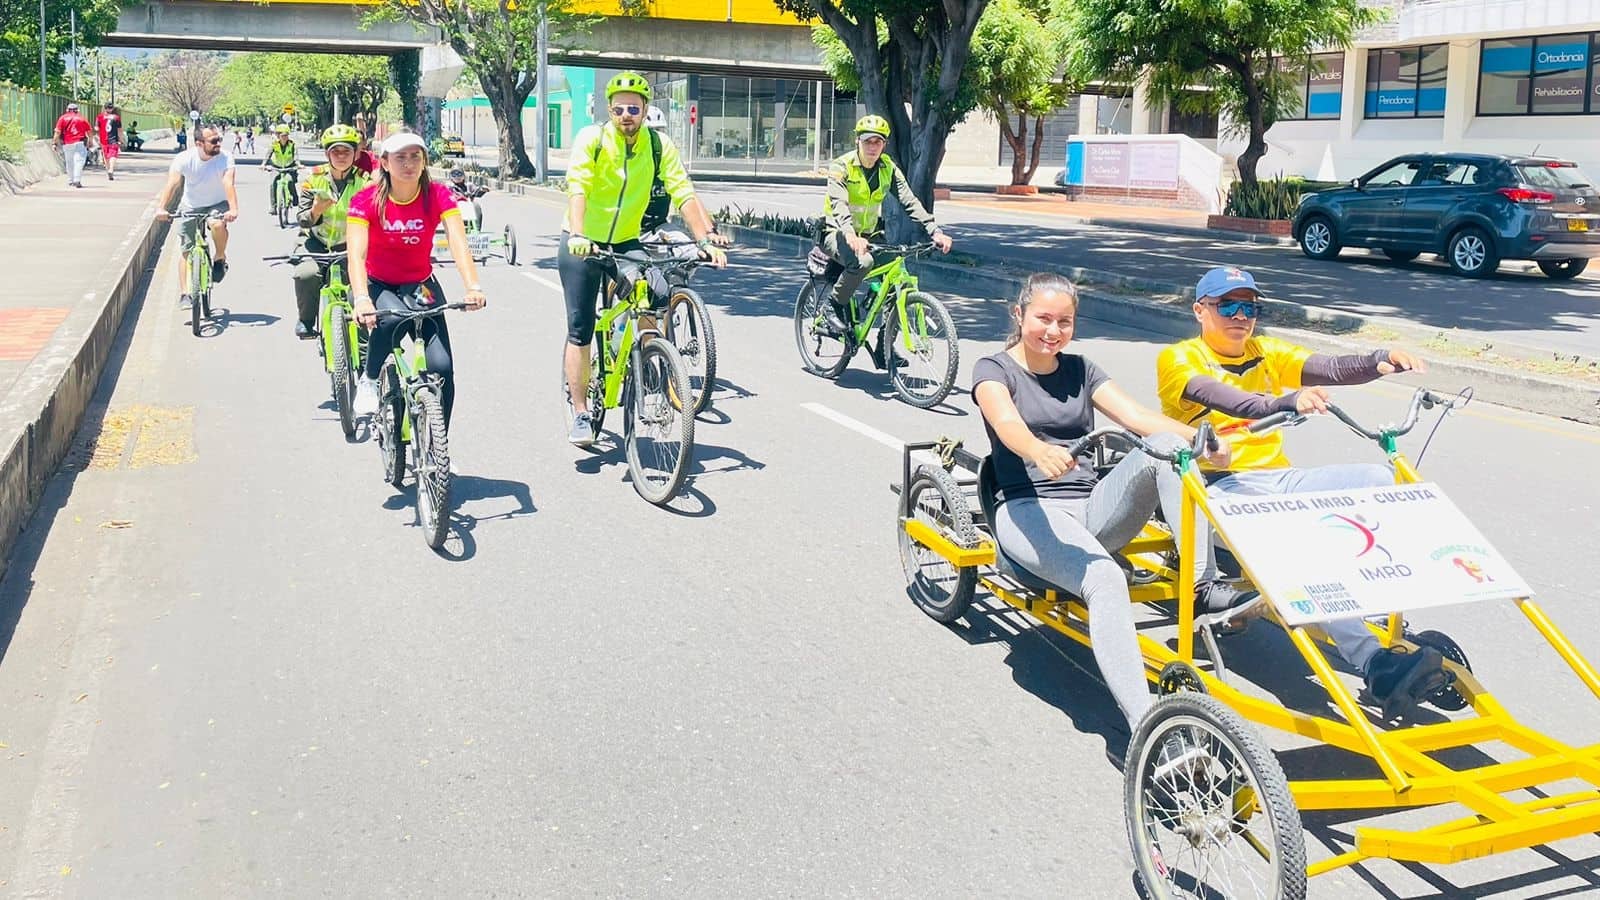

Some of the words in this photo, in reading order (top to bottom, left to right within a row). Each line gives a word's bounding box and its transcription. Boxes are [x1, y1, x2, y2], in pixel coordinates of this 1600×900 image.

[401, 236, 420, 245] 70
[1220, 500, 1309, 516] LOGISTICA
[1310, 495, 1356, 509] IMRD
[1359, 564, 1412, 582] IMRD
